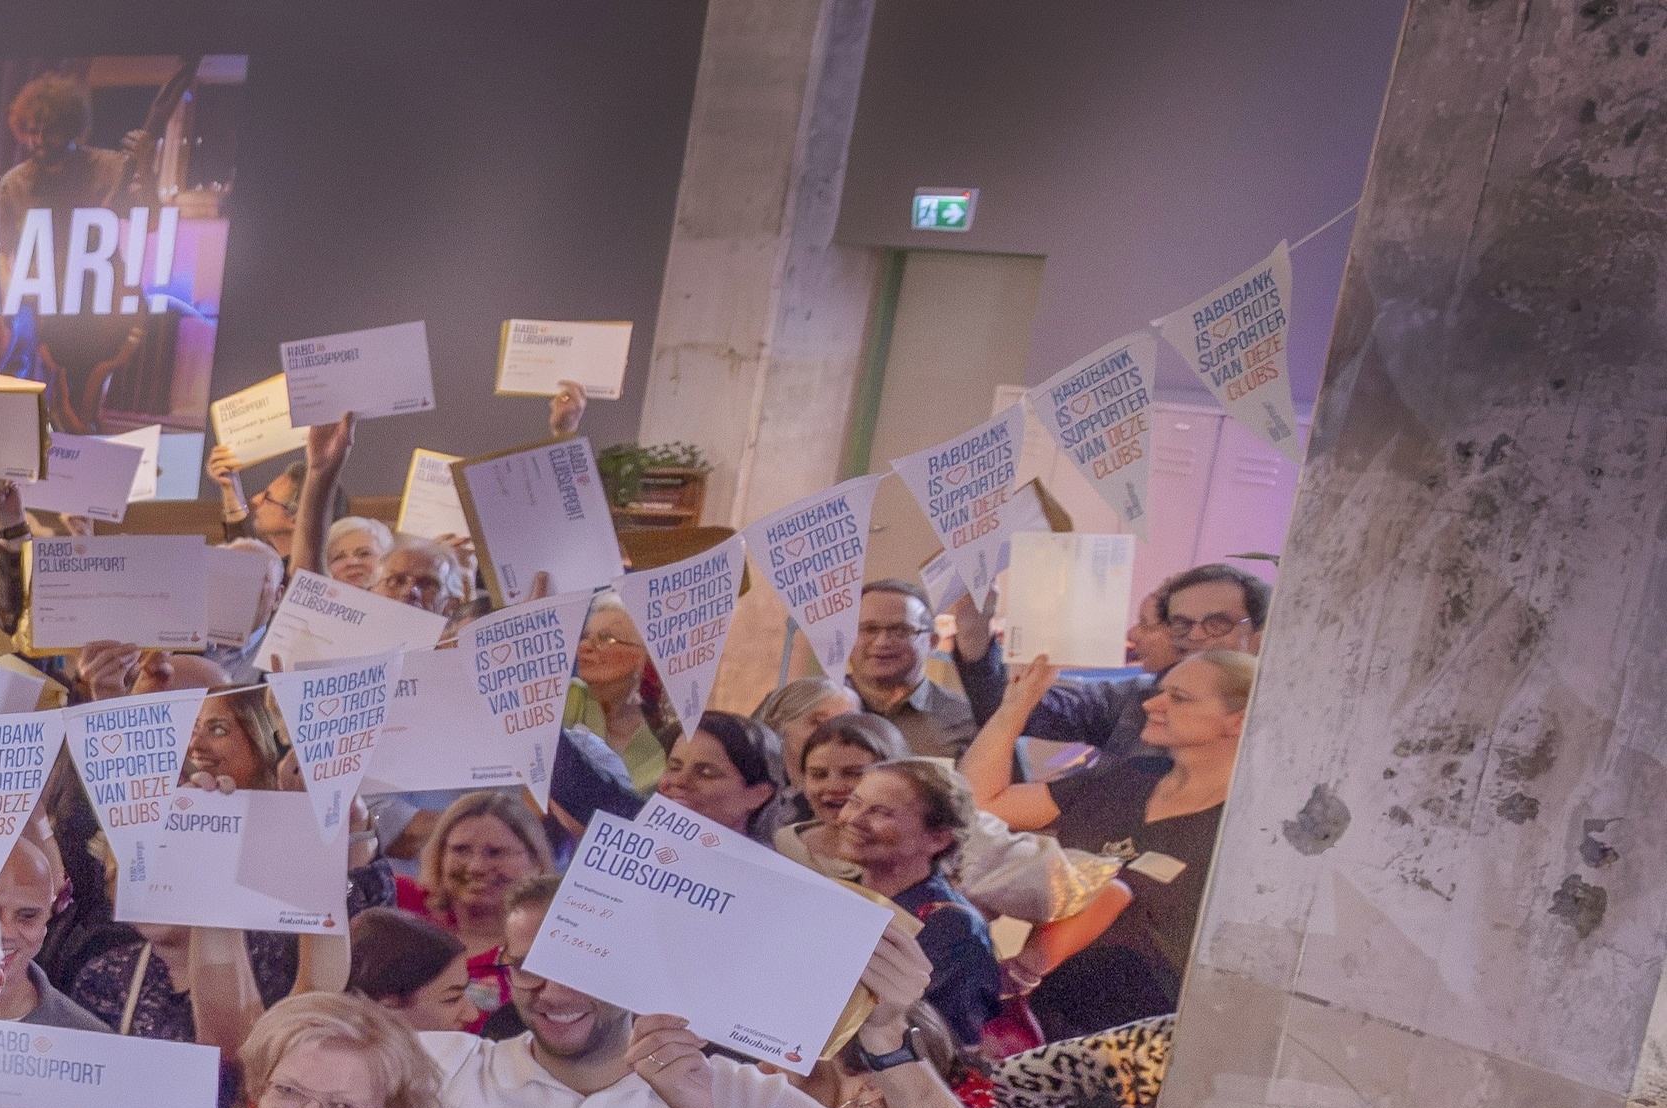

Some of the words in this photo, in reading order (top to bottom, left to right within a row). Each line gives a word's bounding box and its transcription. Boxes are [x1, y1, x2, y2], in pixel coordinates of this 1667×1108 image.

[1193, 267, 1275, 331] RABOBANK
[1196, 326, 1211, 351] IS
[1233, 288, 1281, 325] TROTS
[1198, 309, 1287, 373] SUPPORTER
[1210, 357, 1243, 388] VAN
[1243, 333, 1285, 370] DEZE
[1225, 361, 1279, 402] CLUBS
[38, 542, 73, 557] RABO
[38, 557, 127, 574] CLUBSUPPORT
[647, 597, 663, 620] IS
[689, 571, 733, 606] TROTS
[648, 551, 730, 596] RABOBANK
[647, 598, 734, 643] SUPPORTER
[656, 635, 688, 660] VAN
[690, 617, 727, 648] DEZE
[668, 643, 715, 676] CLUBS
[593, 822, 655, 860] RABO
[647, 805, 701, 841] RABO
[584, 846, 736, 914] CLUBSUPPORT
